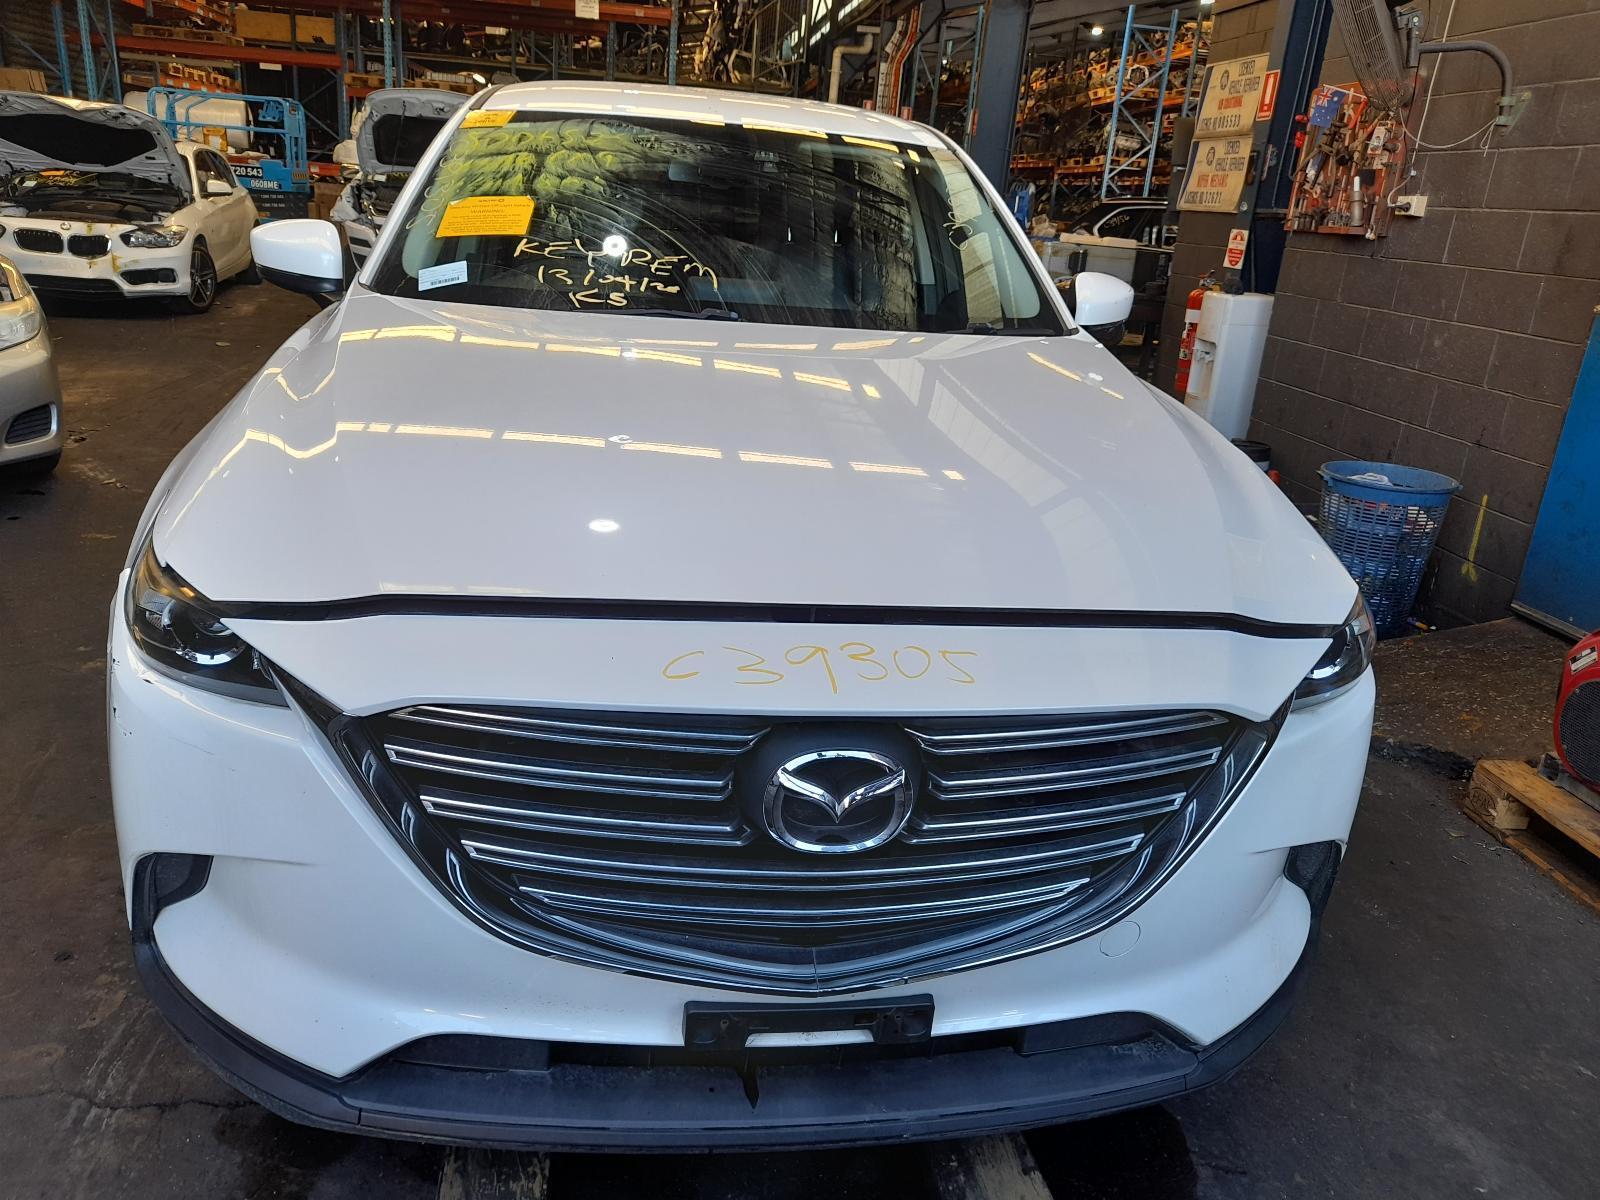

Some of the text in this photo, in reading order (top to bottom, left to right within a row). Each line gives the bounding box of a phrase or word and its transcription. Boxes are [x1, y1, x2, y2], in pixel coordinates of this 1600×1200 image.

[247, 168, 263, 177] 543
[514, 238, 608, 267] KEY
[568, 288, 628, 309] KS
[662, 641, 978, 695] C39305
